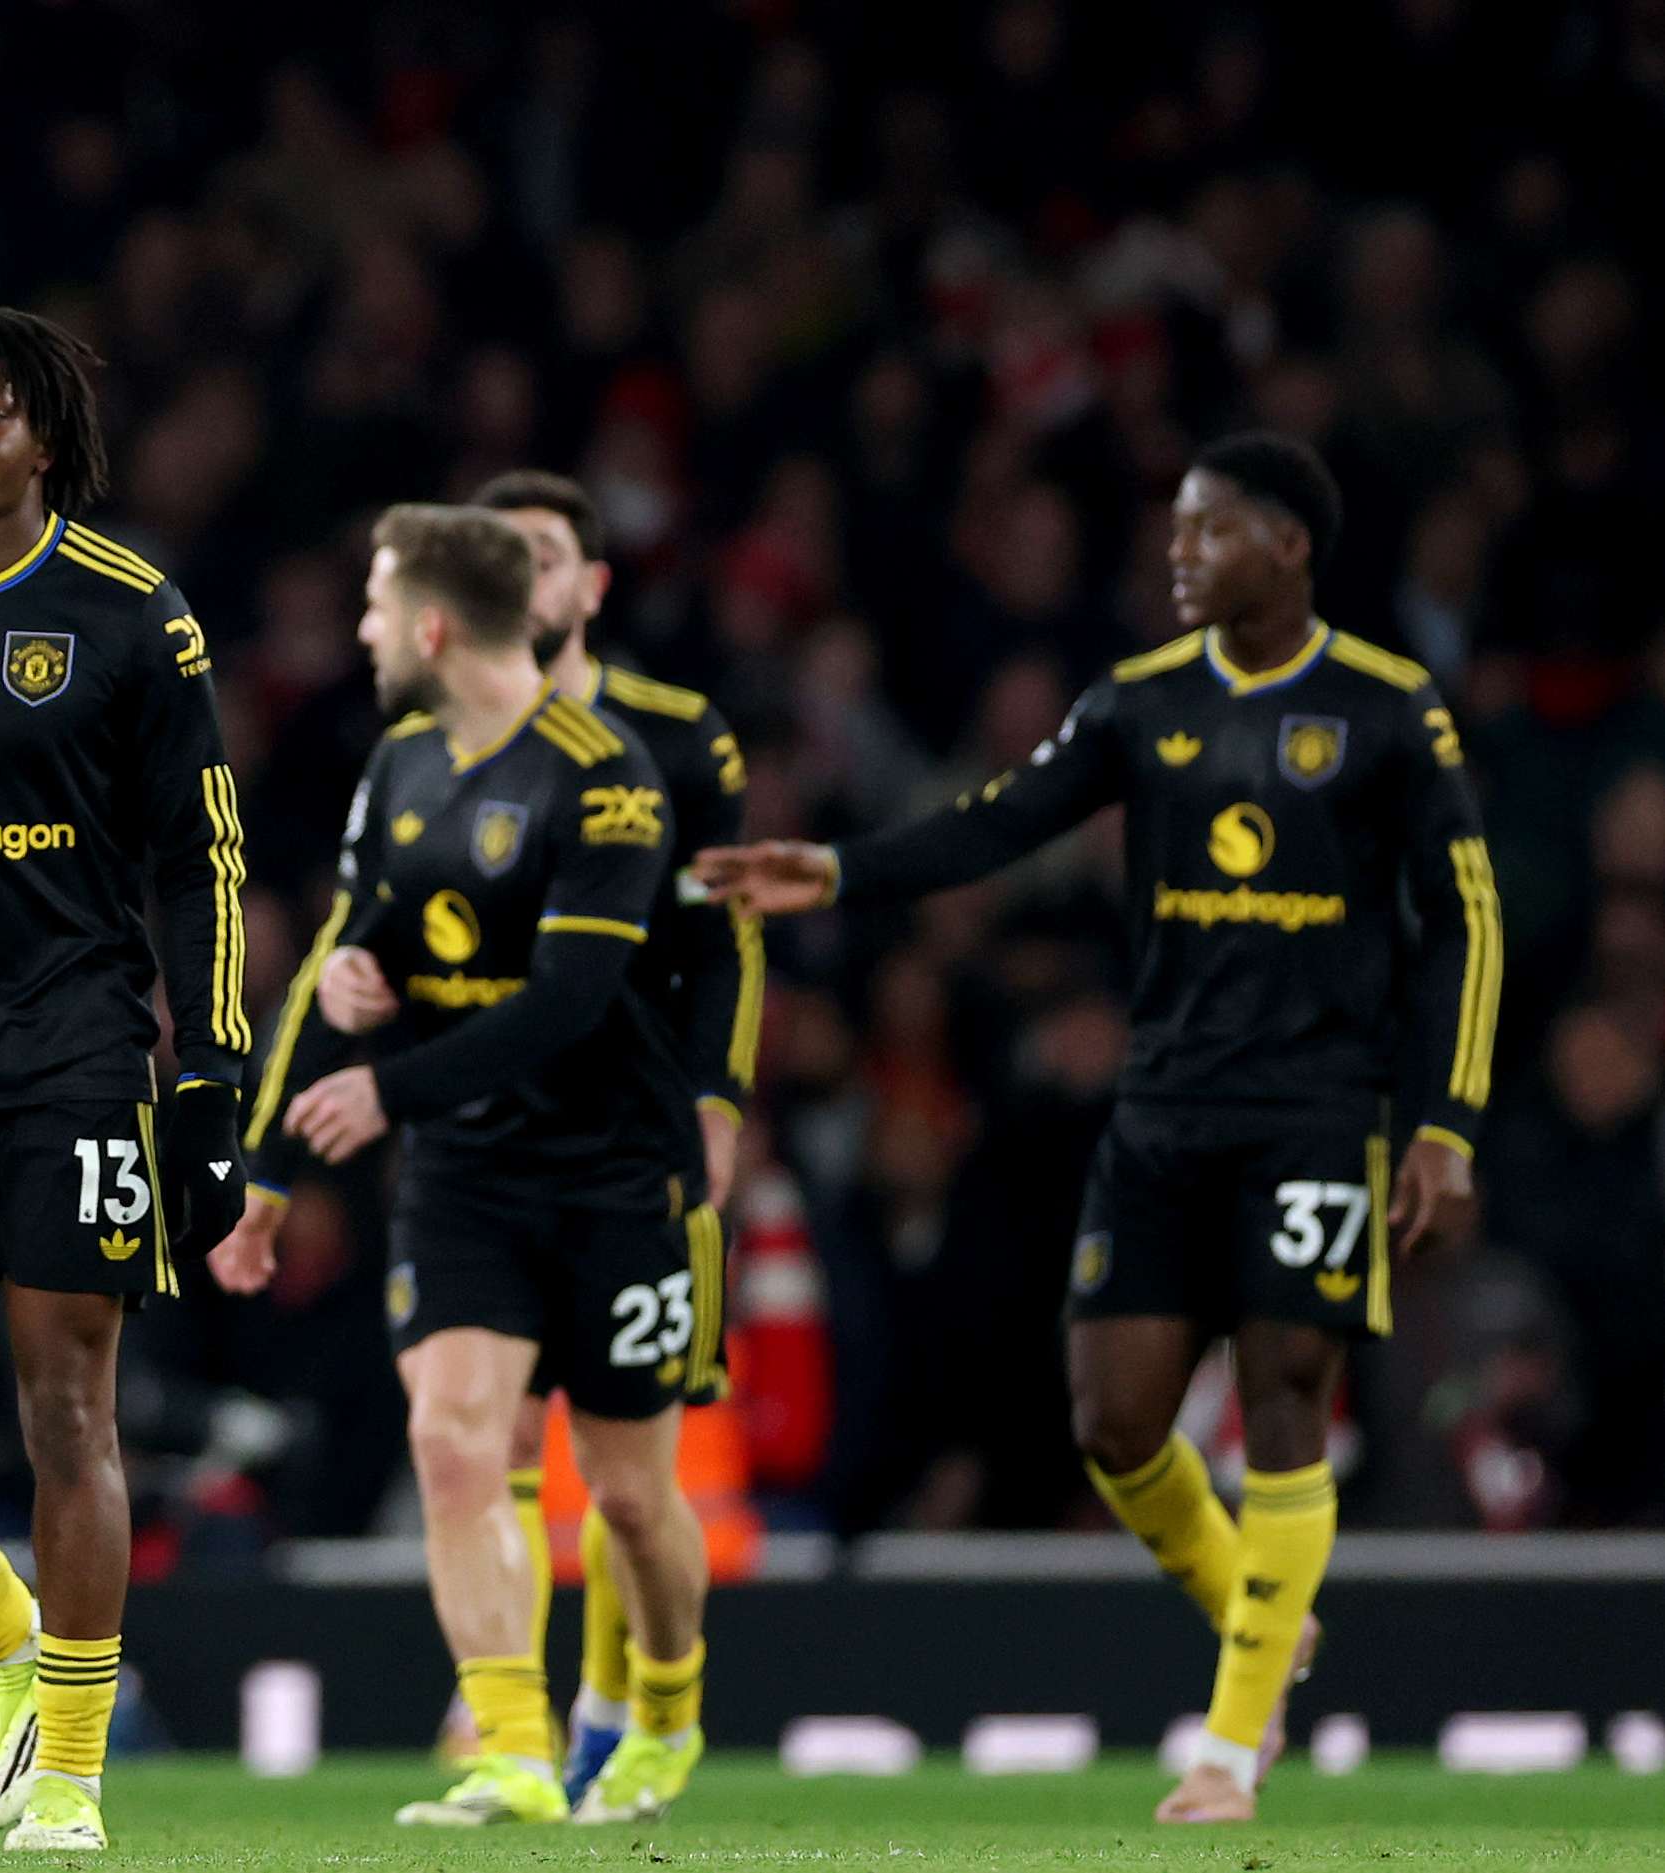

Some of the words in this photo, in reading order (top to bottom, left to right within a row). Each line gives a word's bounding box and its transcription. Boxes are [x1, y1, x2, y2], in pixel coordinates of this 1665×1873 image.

[73, 1137, 152, 1226] 13
[1268, 1180, 1371, 1269] 37
[608, 1269, 695, 1368] 23
